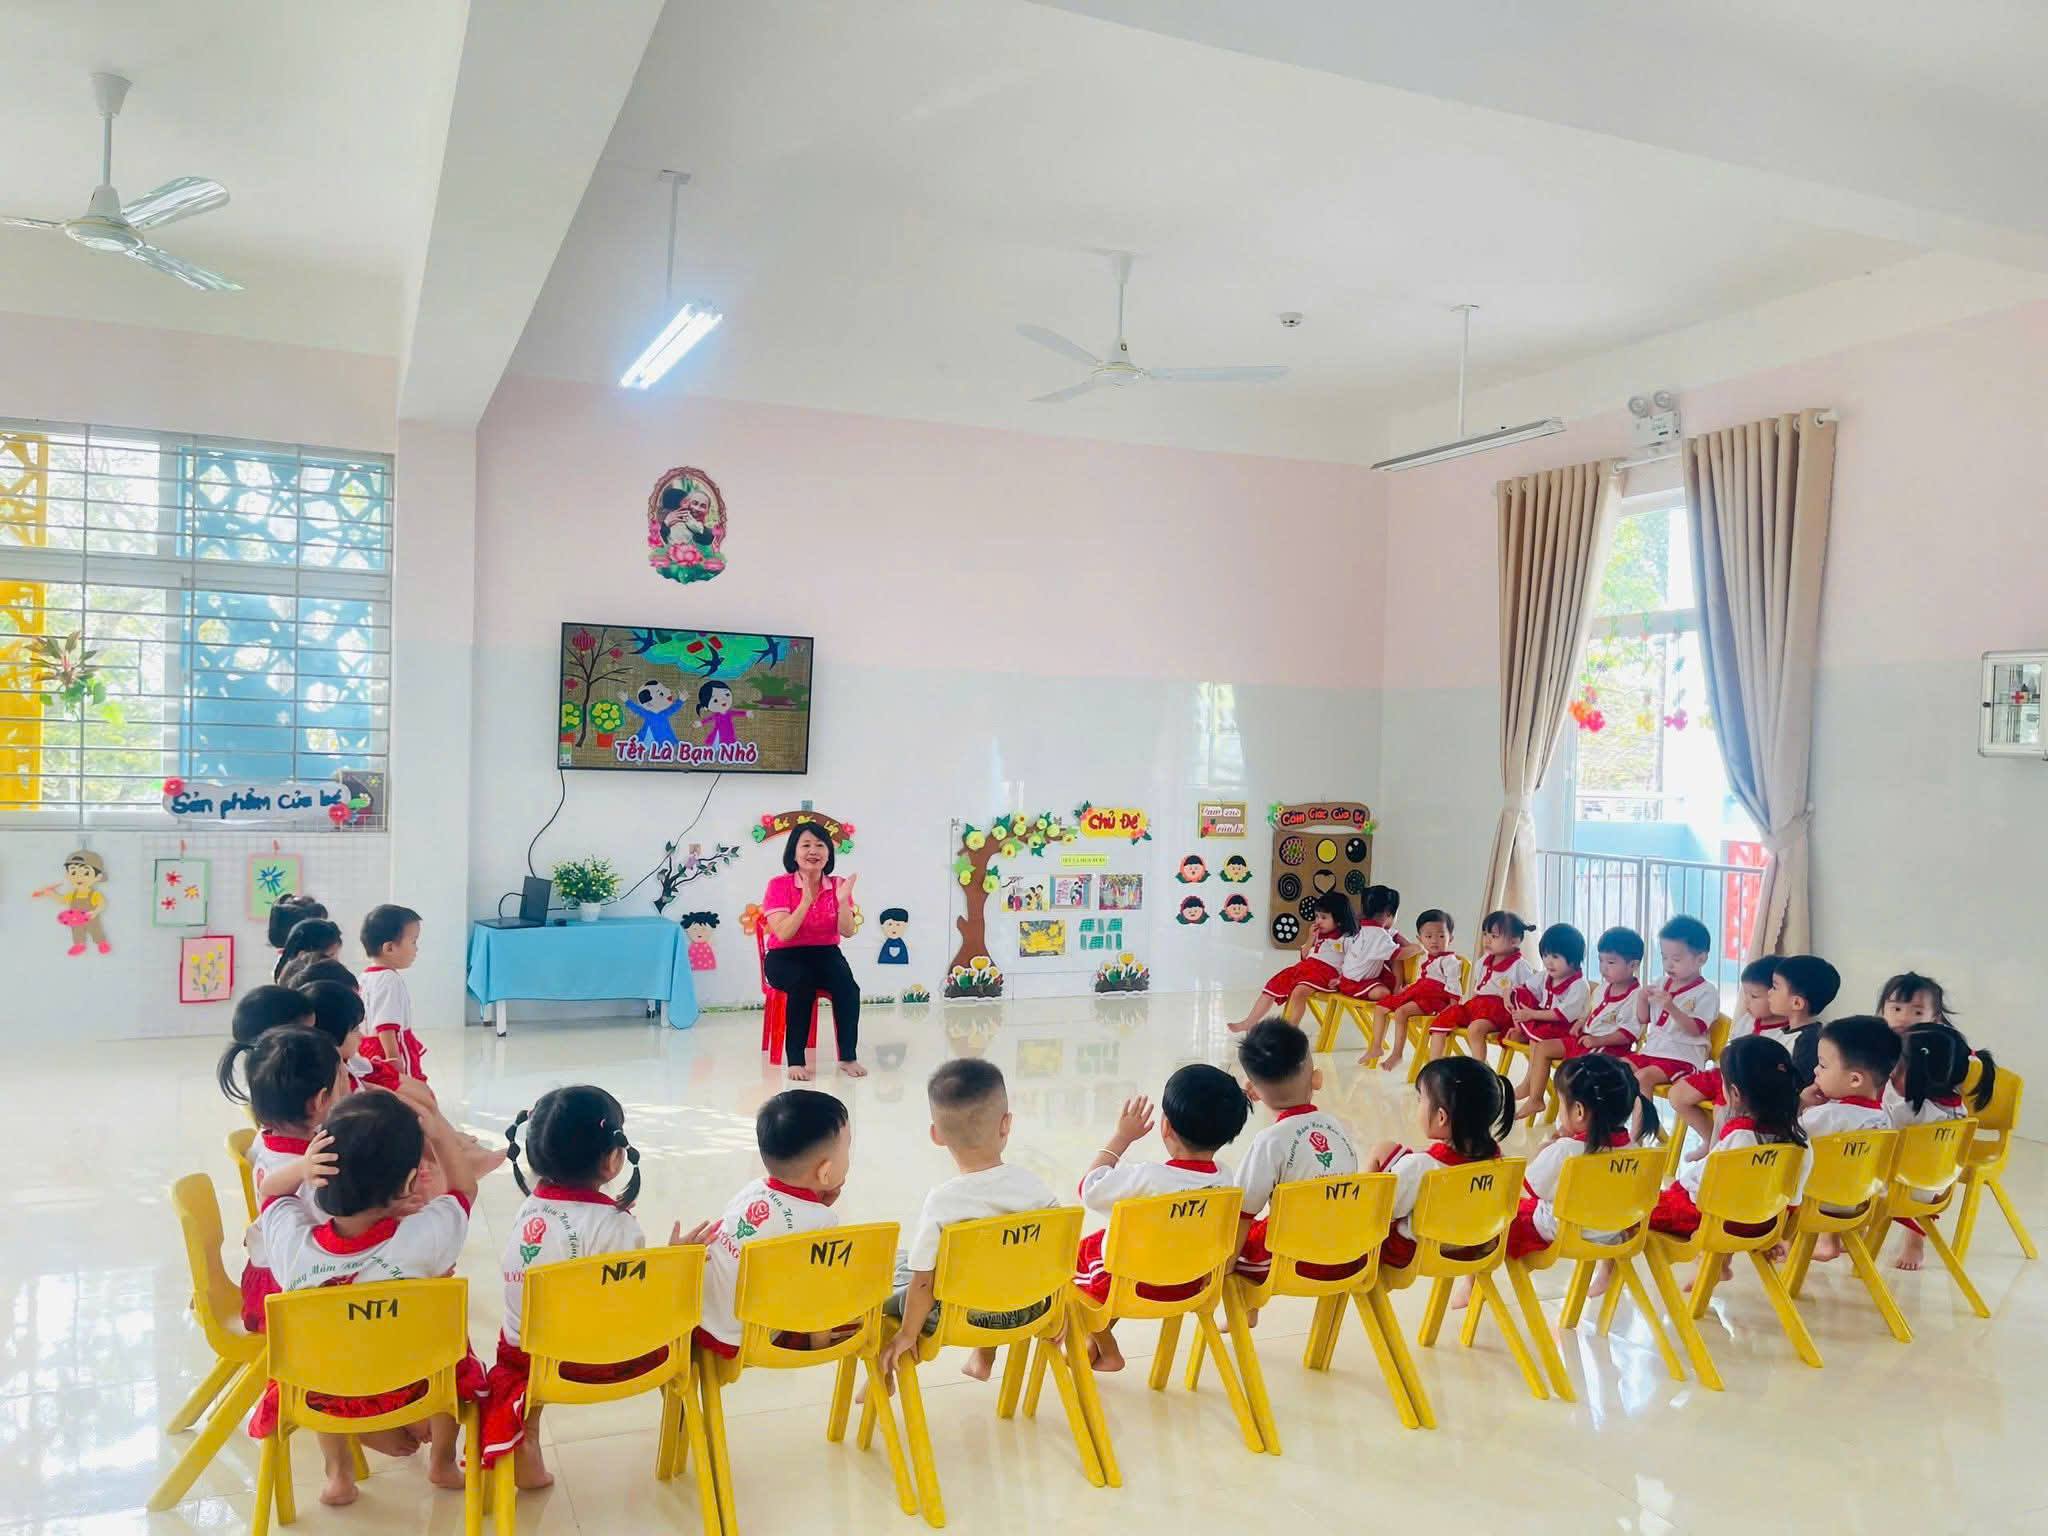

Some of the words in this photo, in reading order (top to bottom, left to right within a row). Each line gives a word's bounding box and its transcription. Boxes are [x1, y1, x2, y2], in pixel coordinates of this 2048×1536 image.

[616, 736, 645, 760] Tết
[650, 740, 673, 760] Là
[679, 742, 714, 764] Bạn
[720, 742, 757, 762] Nhỏ
[171, 792, 213, 814] Sản
[1610, 1158, 1640, 1174] NT1
[1751, 1150, 1778, 1167] NT1
[1326, 1182, 1360, 1200] NT1
[1170, 1199, 1208, 1218] NT1
[1002, 1224, 1041, 1245] NT1
[811, 1240, 853, 1267] NT1
[601, 1260, 646, 1286] NT1
[348, 1298, 399, 1320] NT1
